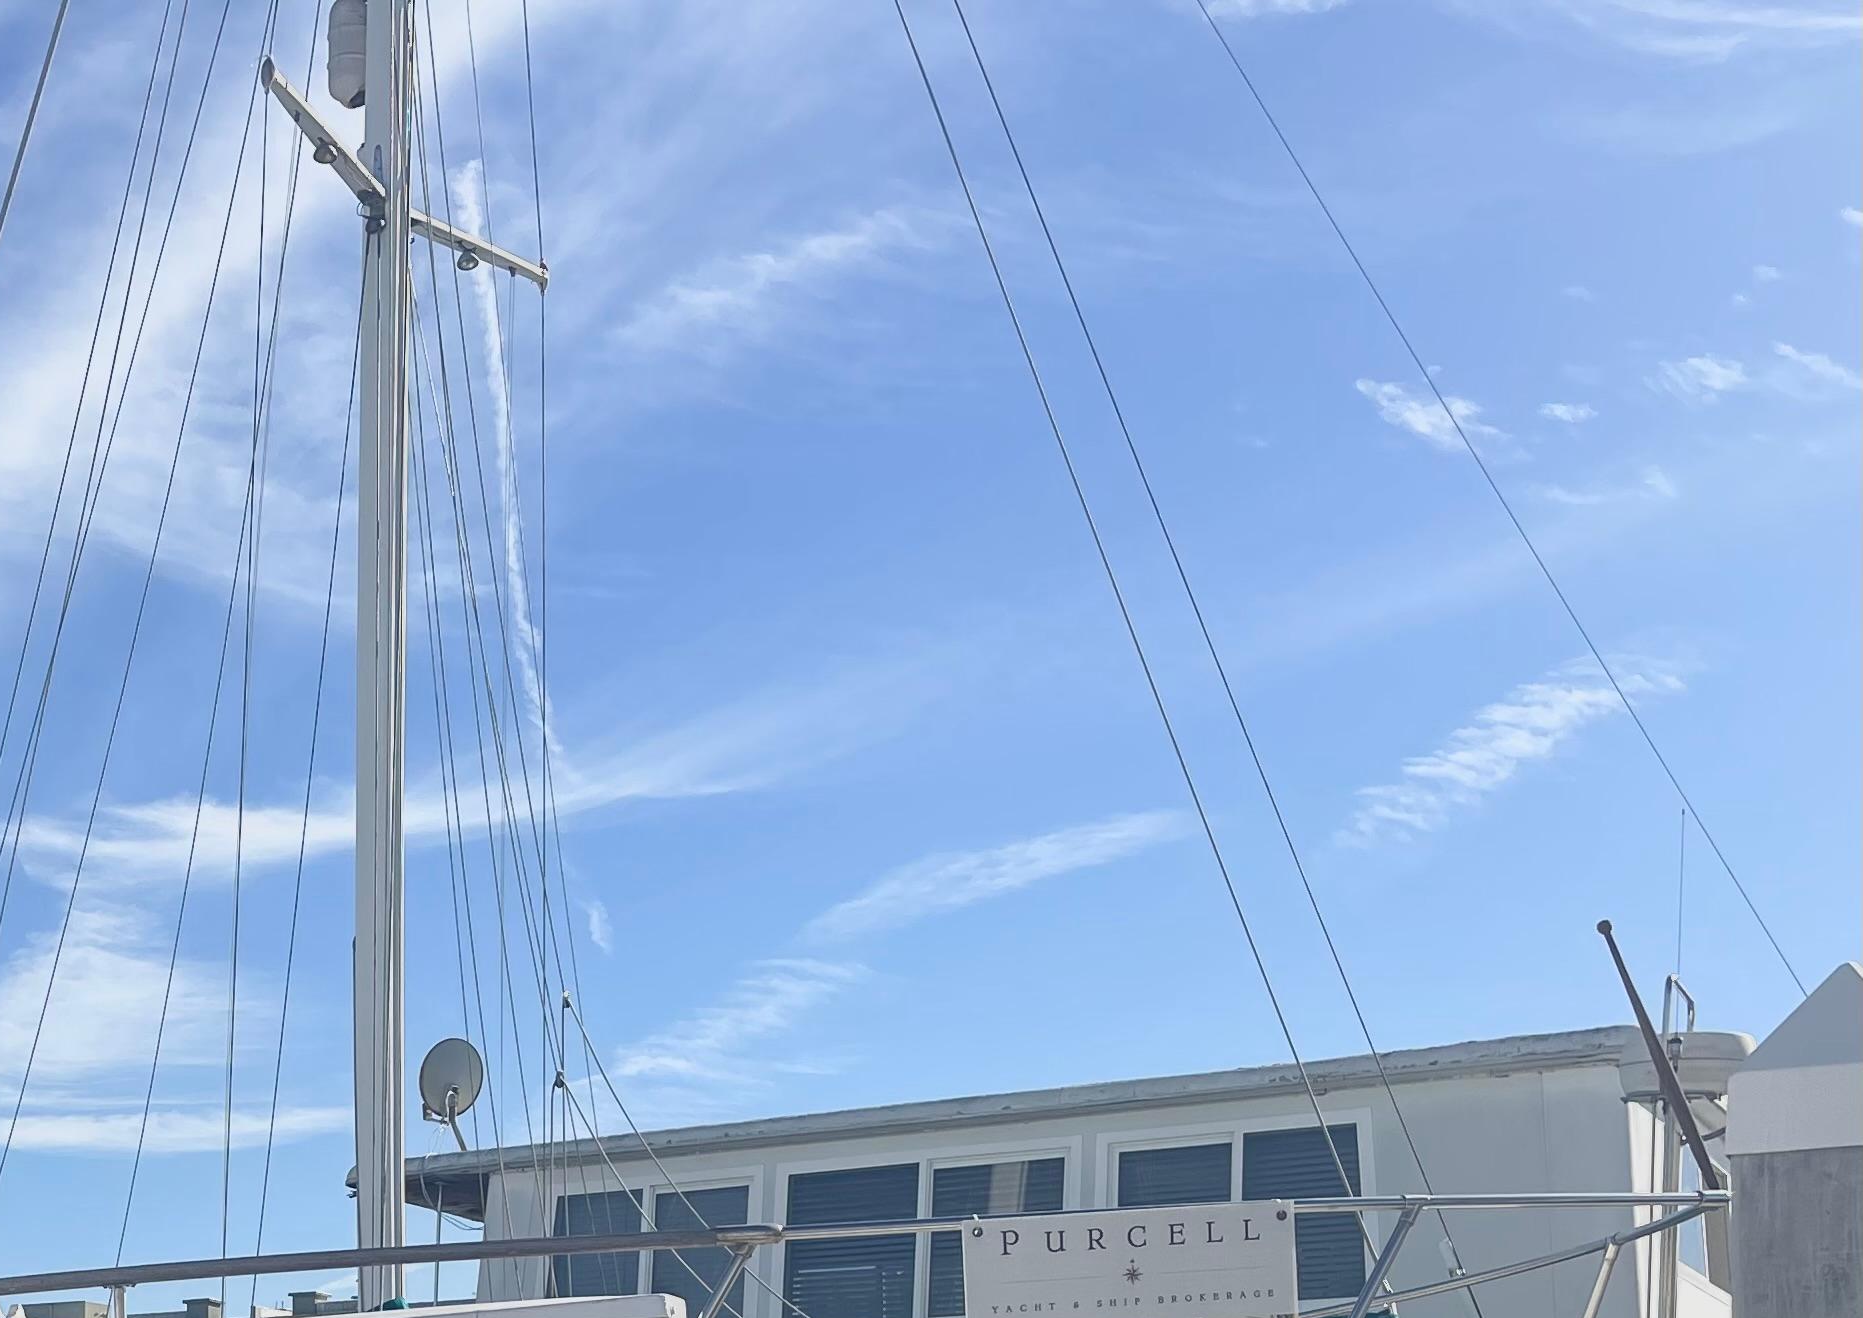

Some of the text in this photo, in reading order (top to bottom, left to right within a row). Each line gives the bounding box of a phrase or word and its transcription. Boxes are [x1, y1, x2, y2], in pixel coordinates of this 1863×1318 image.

[999, 1218, 1261, 1256] PURCELL
[991, 1302, 1057, 1315] YACHT
[1096, 1297, 1142, 1308] SHIP
[1157, 1288, 1276, 1305] BROKERAGE
